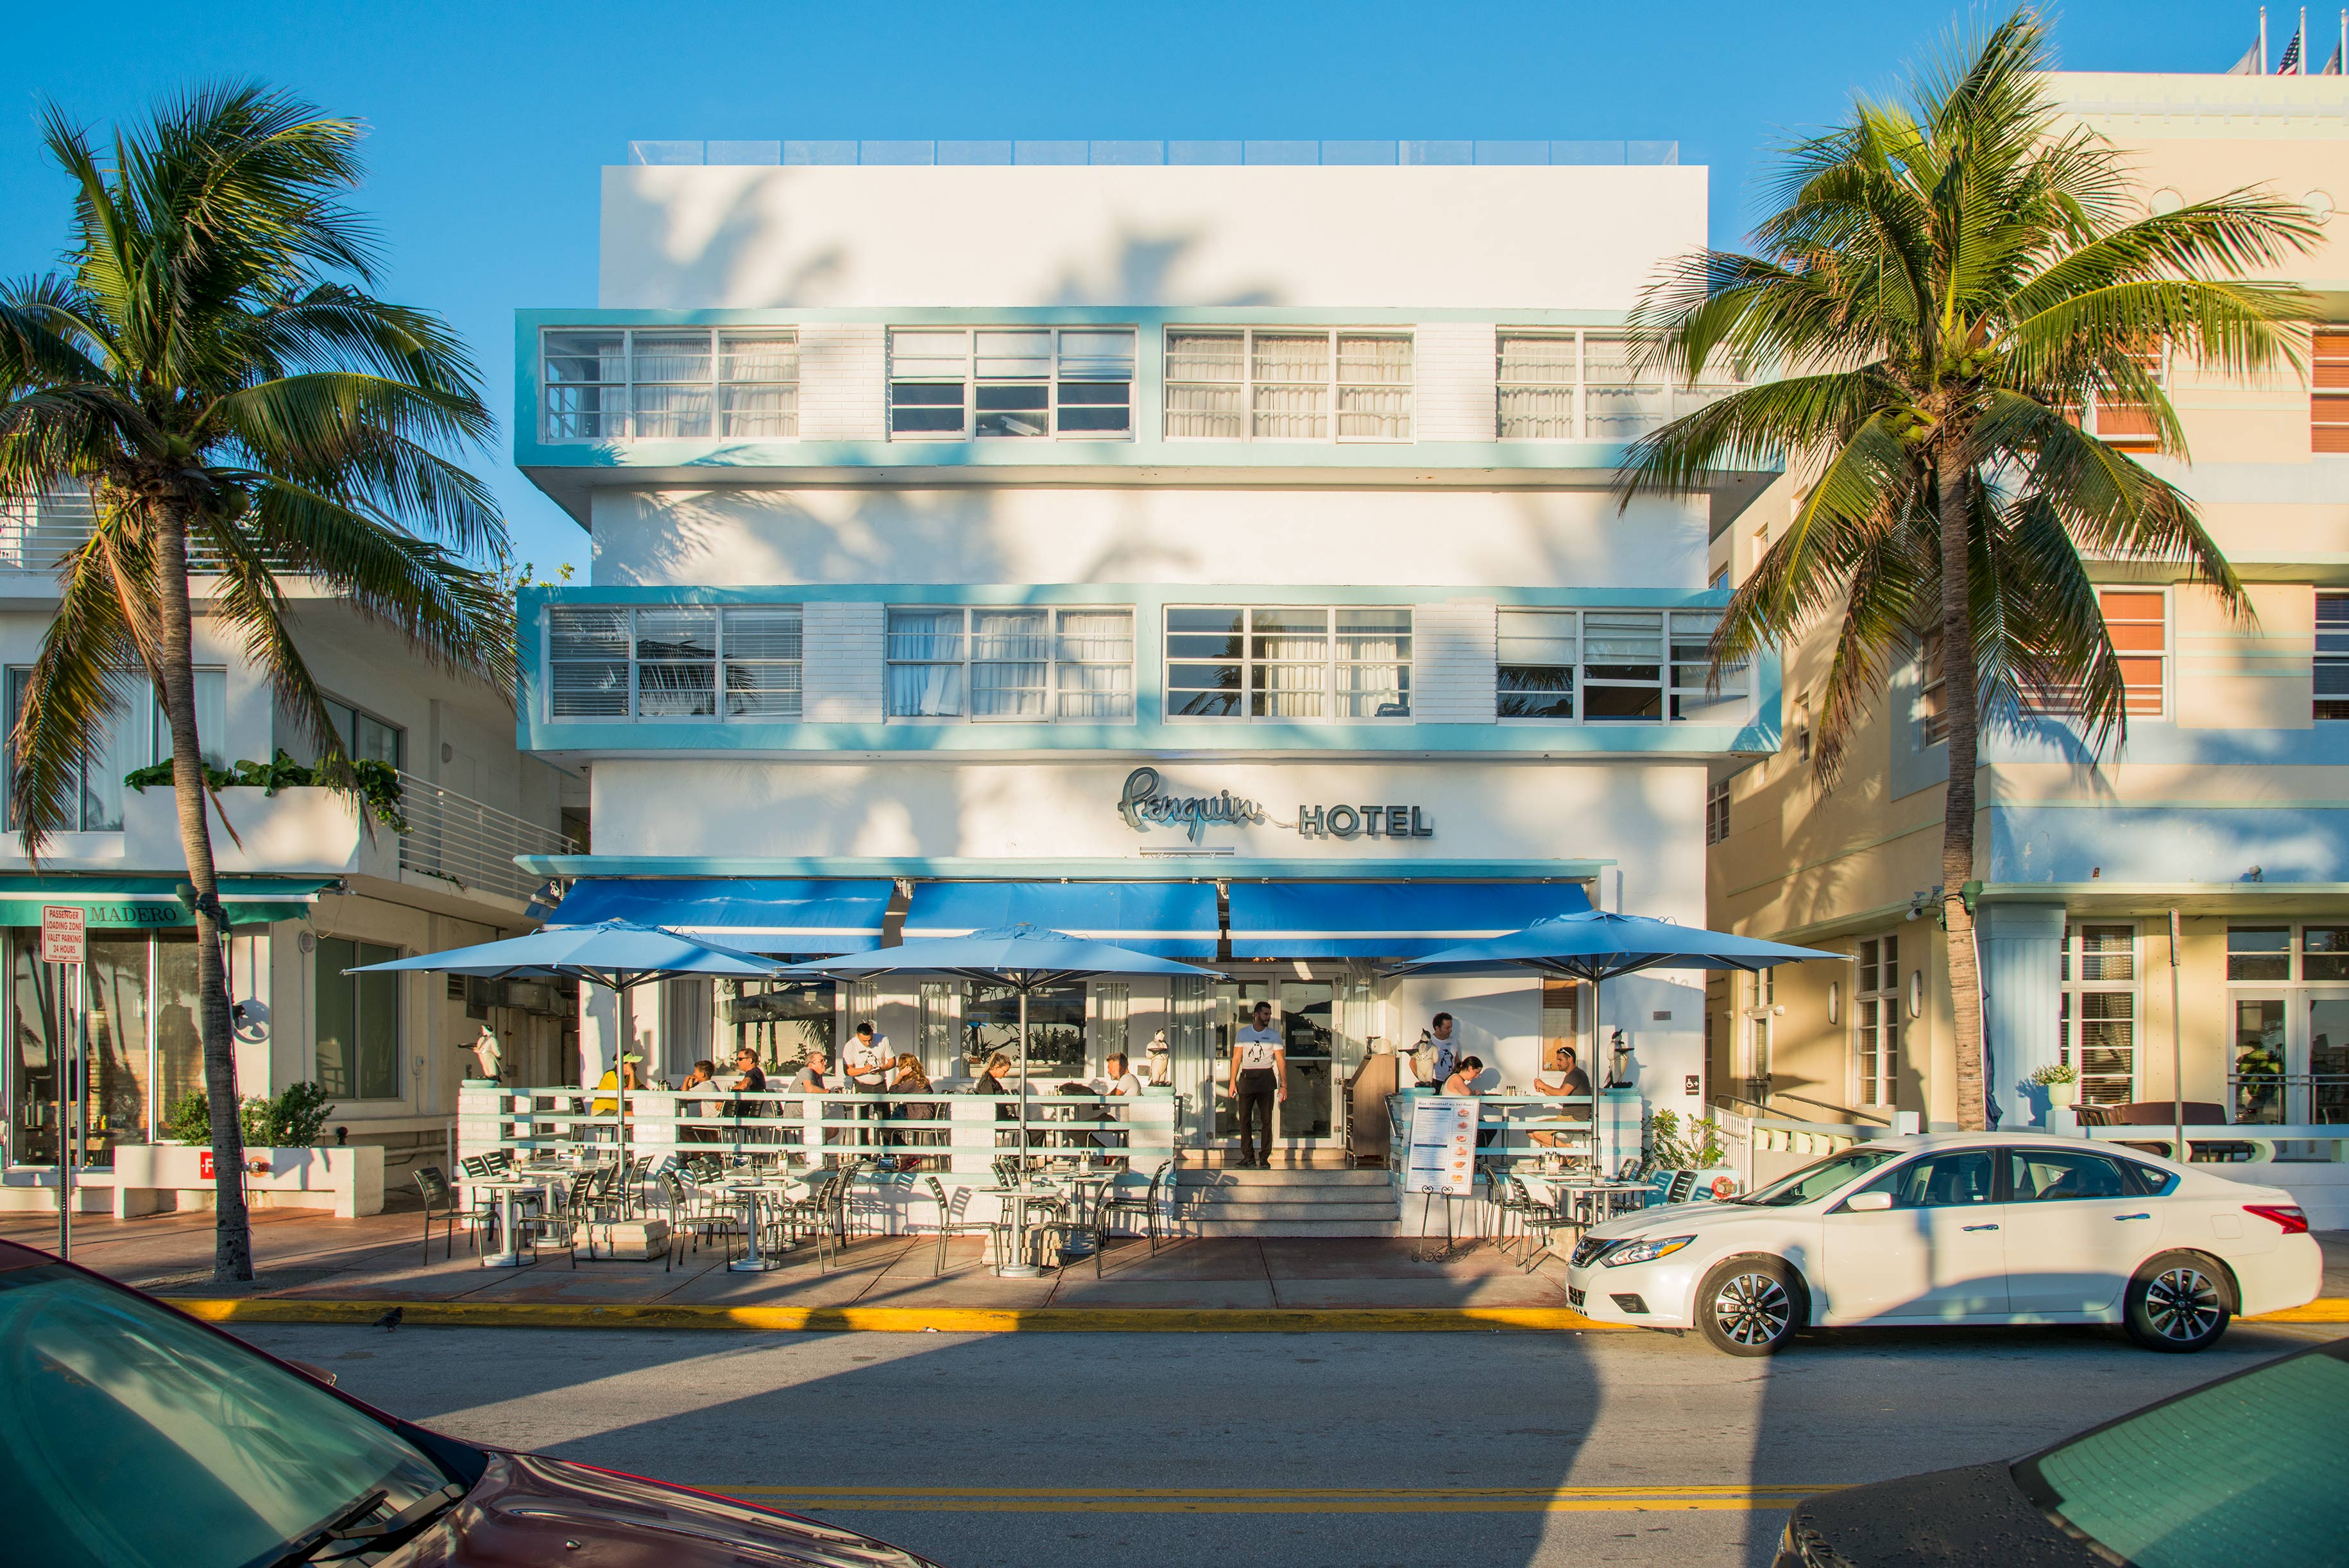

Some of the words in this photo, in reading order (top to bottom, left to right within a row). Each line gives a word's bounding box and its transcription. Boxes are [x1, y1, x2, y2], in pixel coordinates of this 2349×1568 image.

[1117, 767, 1260, 842] Penguin
[1299, 804, 1433, 837] HOTEL
[49, 910, 79, 919] PASSENGER
[89, 907, 177, 923] MADERO
[47, 921, 68, 930] LOADING
[69, 922, 82, 931] ZONE
[47, 933, 60, 942] VALET
[62, 934, 82, 943] PARKING
[53, 944, 59, 953] 24
[60, 945, 76, 953] HOURS
